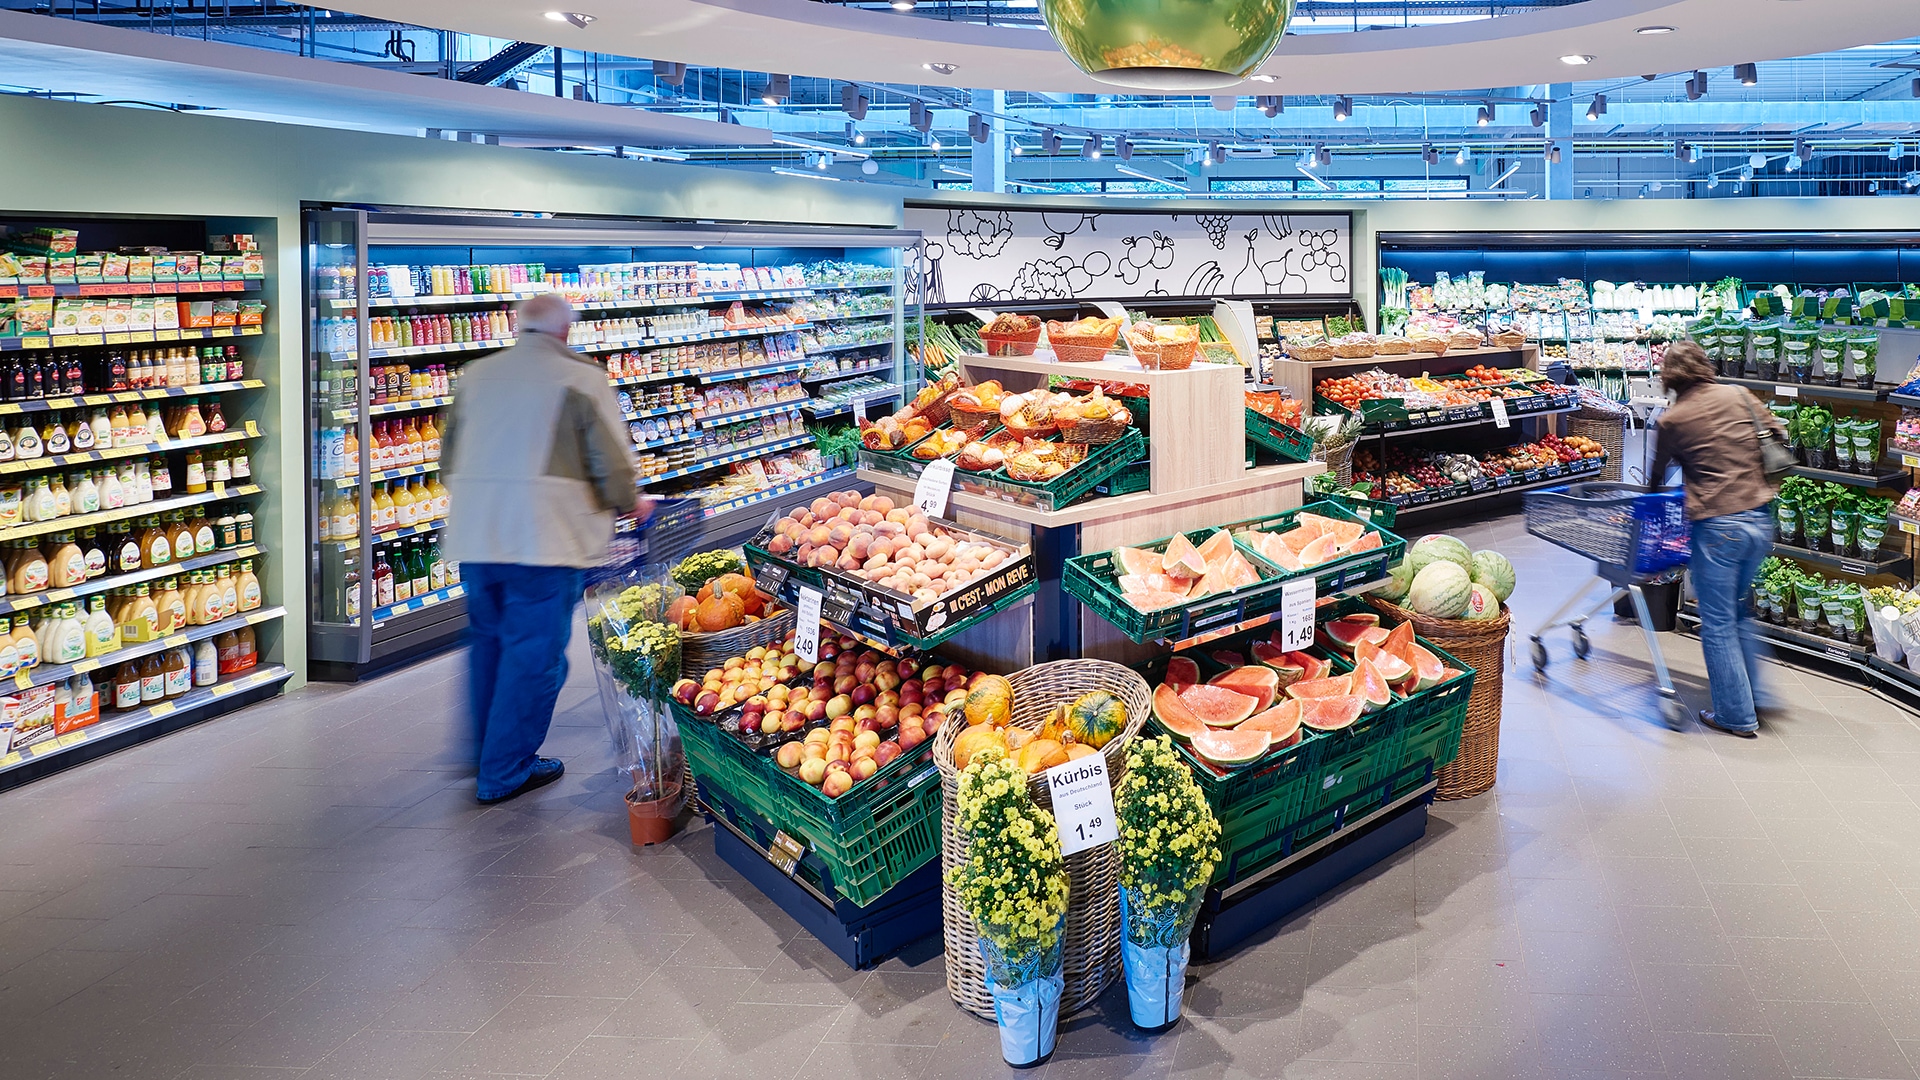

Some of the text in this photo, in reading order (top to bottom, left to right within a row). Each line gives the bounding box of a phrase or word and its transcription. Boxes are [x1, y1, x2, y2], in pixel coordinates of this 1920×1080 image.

[985, 574, 1007, 597] MON
[1006, 564, 1029, 586] REVE
[796, 635, 813, 655] 2,49
[1288, 625, 1312, 646] 1,49
[16, 725, 52, 745] CROUTONS
[1052, 764, 1103, 788] Kürbis
[1070, 780, 1103, 795] Deutschland
[1074, 801, 1092, 810] Stück
